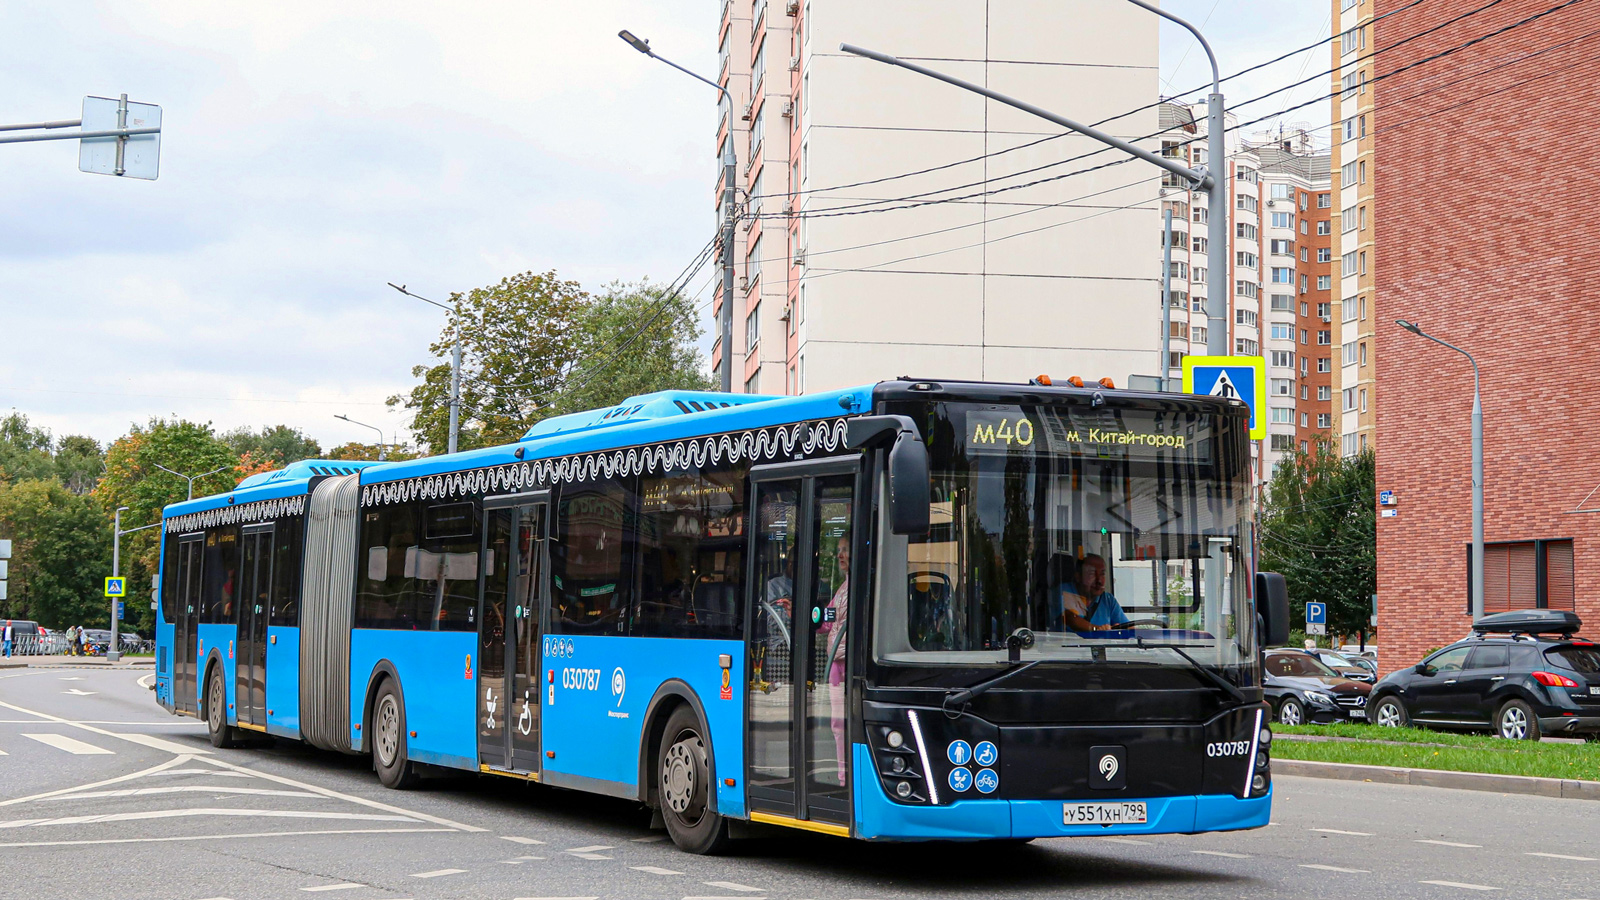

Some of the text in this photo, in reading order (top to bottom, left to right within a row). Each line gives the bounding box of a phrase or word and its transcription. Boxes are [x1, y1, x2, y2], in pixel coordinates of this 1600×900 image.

[1089, 428, 1186, 449] Китай-город
[1310, 604, 1322, 622] P
[562, 667, 601, 691] 030787
[1206, 740, 1251, 757] 030787
[1123, 804, 1144, 817] 799
